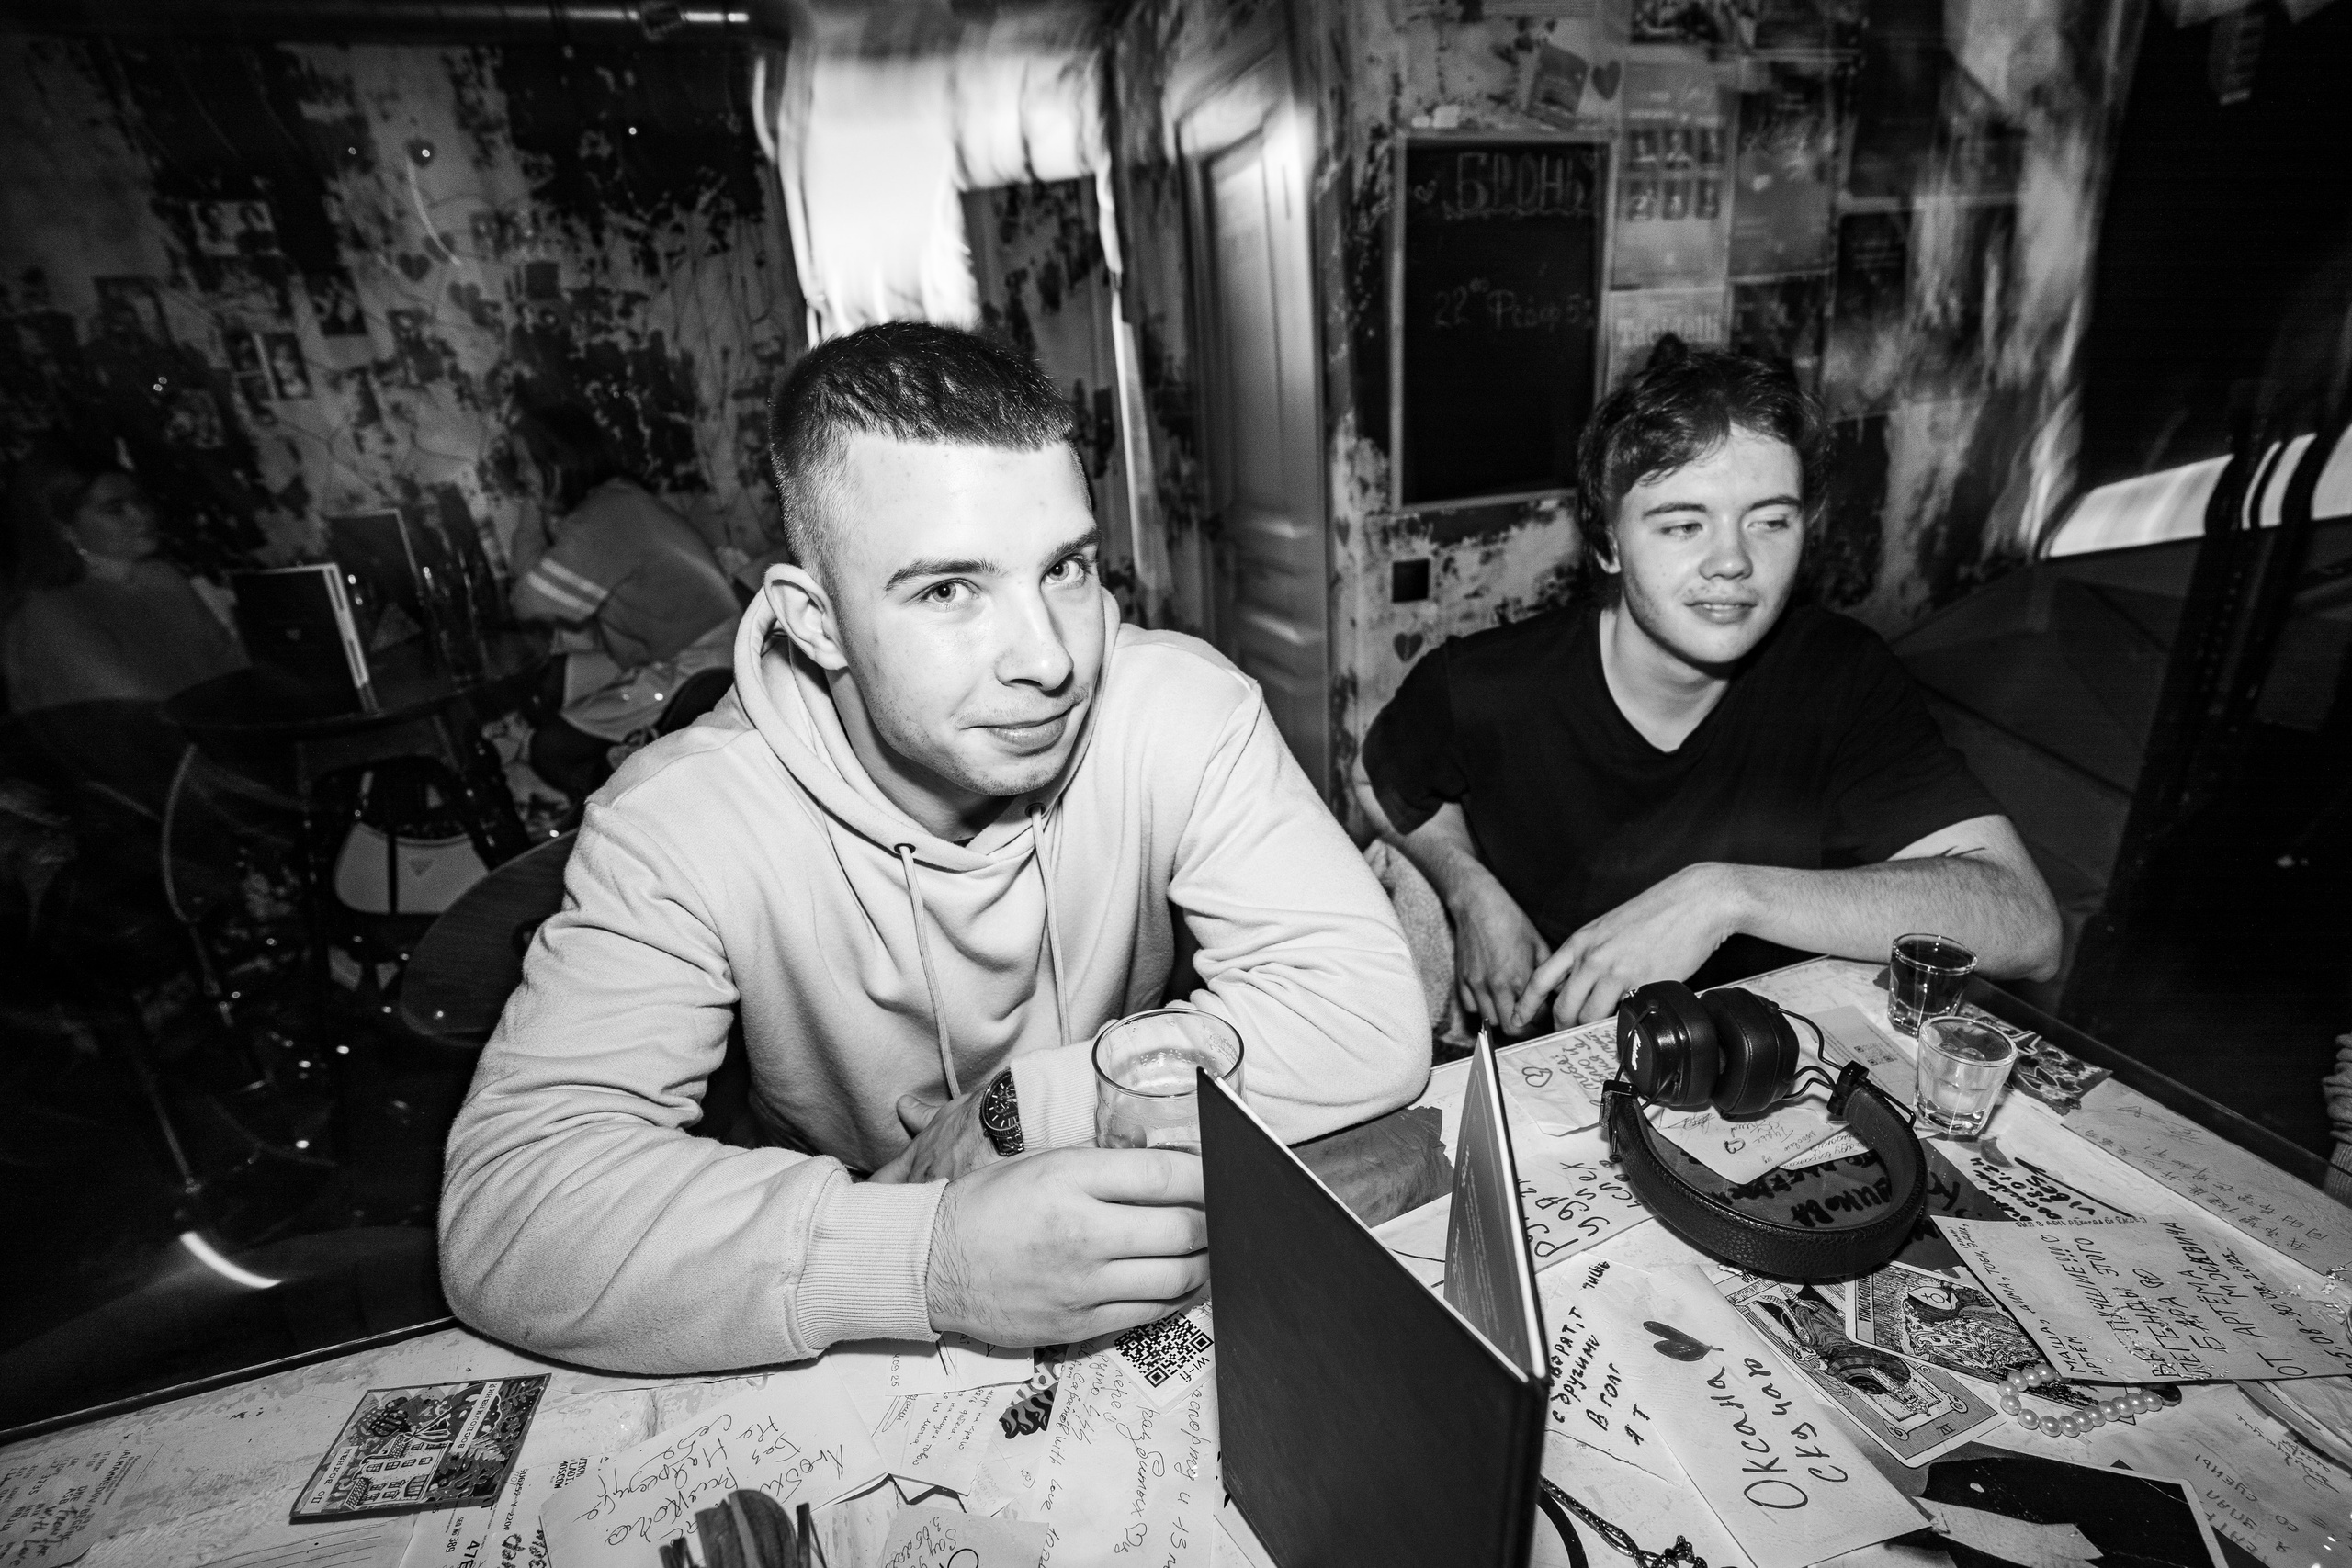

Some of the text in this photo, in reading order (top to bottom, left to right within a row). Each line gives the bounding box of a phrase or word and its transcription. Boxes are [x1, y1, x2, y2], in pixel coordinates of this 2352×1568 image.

[1455, 152, 1586, 214] БРОНЬ
[2074, 1236, 2120, 1278] ЭТОГО
[1179, 1356, 1211, 1383] Wi-fi
[2257, 1351, 2308, 1376] ОТ
[457, 1382, 499, 1450] воспоминаний
[736, 1415, 779, 1442] Не
[1173, 1384, 1212, 1482] аспорту
[751, 1430, 802, 1466] Без
[1706, 1365, 1809, 1510] Оксана
[28, 1473, 51, 1496] 3235
[69, 1484, 89, 1503] DME
[310, 1449, 350, 1505] По волнам
[2194, 1451, 2301, 1533] СО СЦЕНЫ
[2205, 1489, 2259, 1531] УПАЛ
